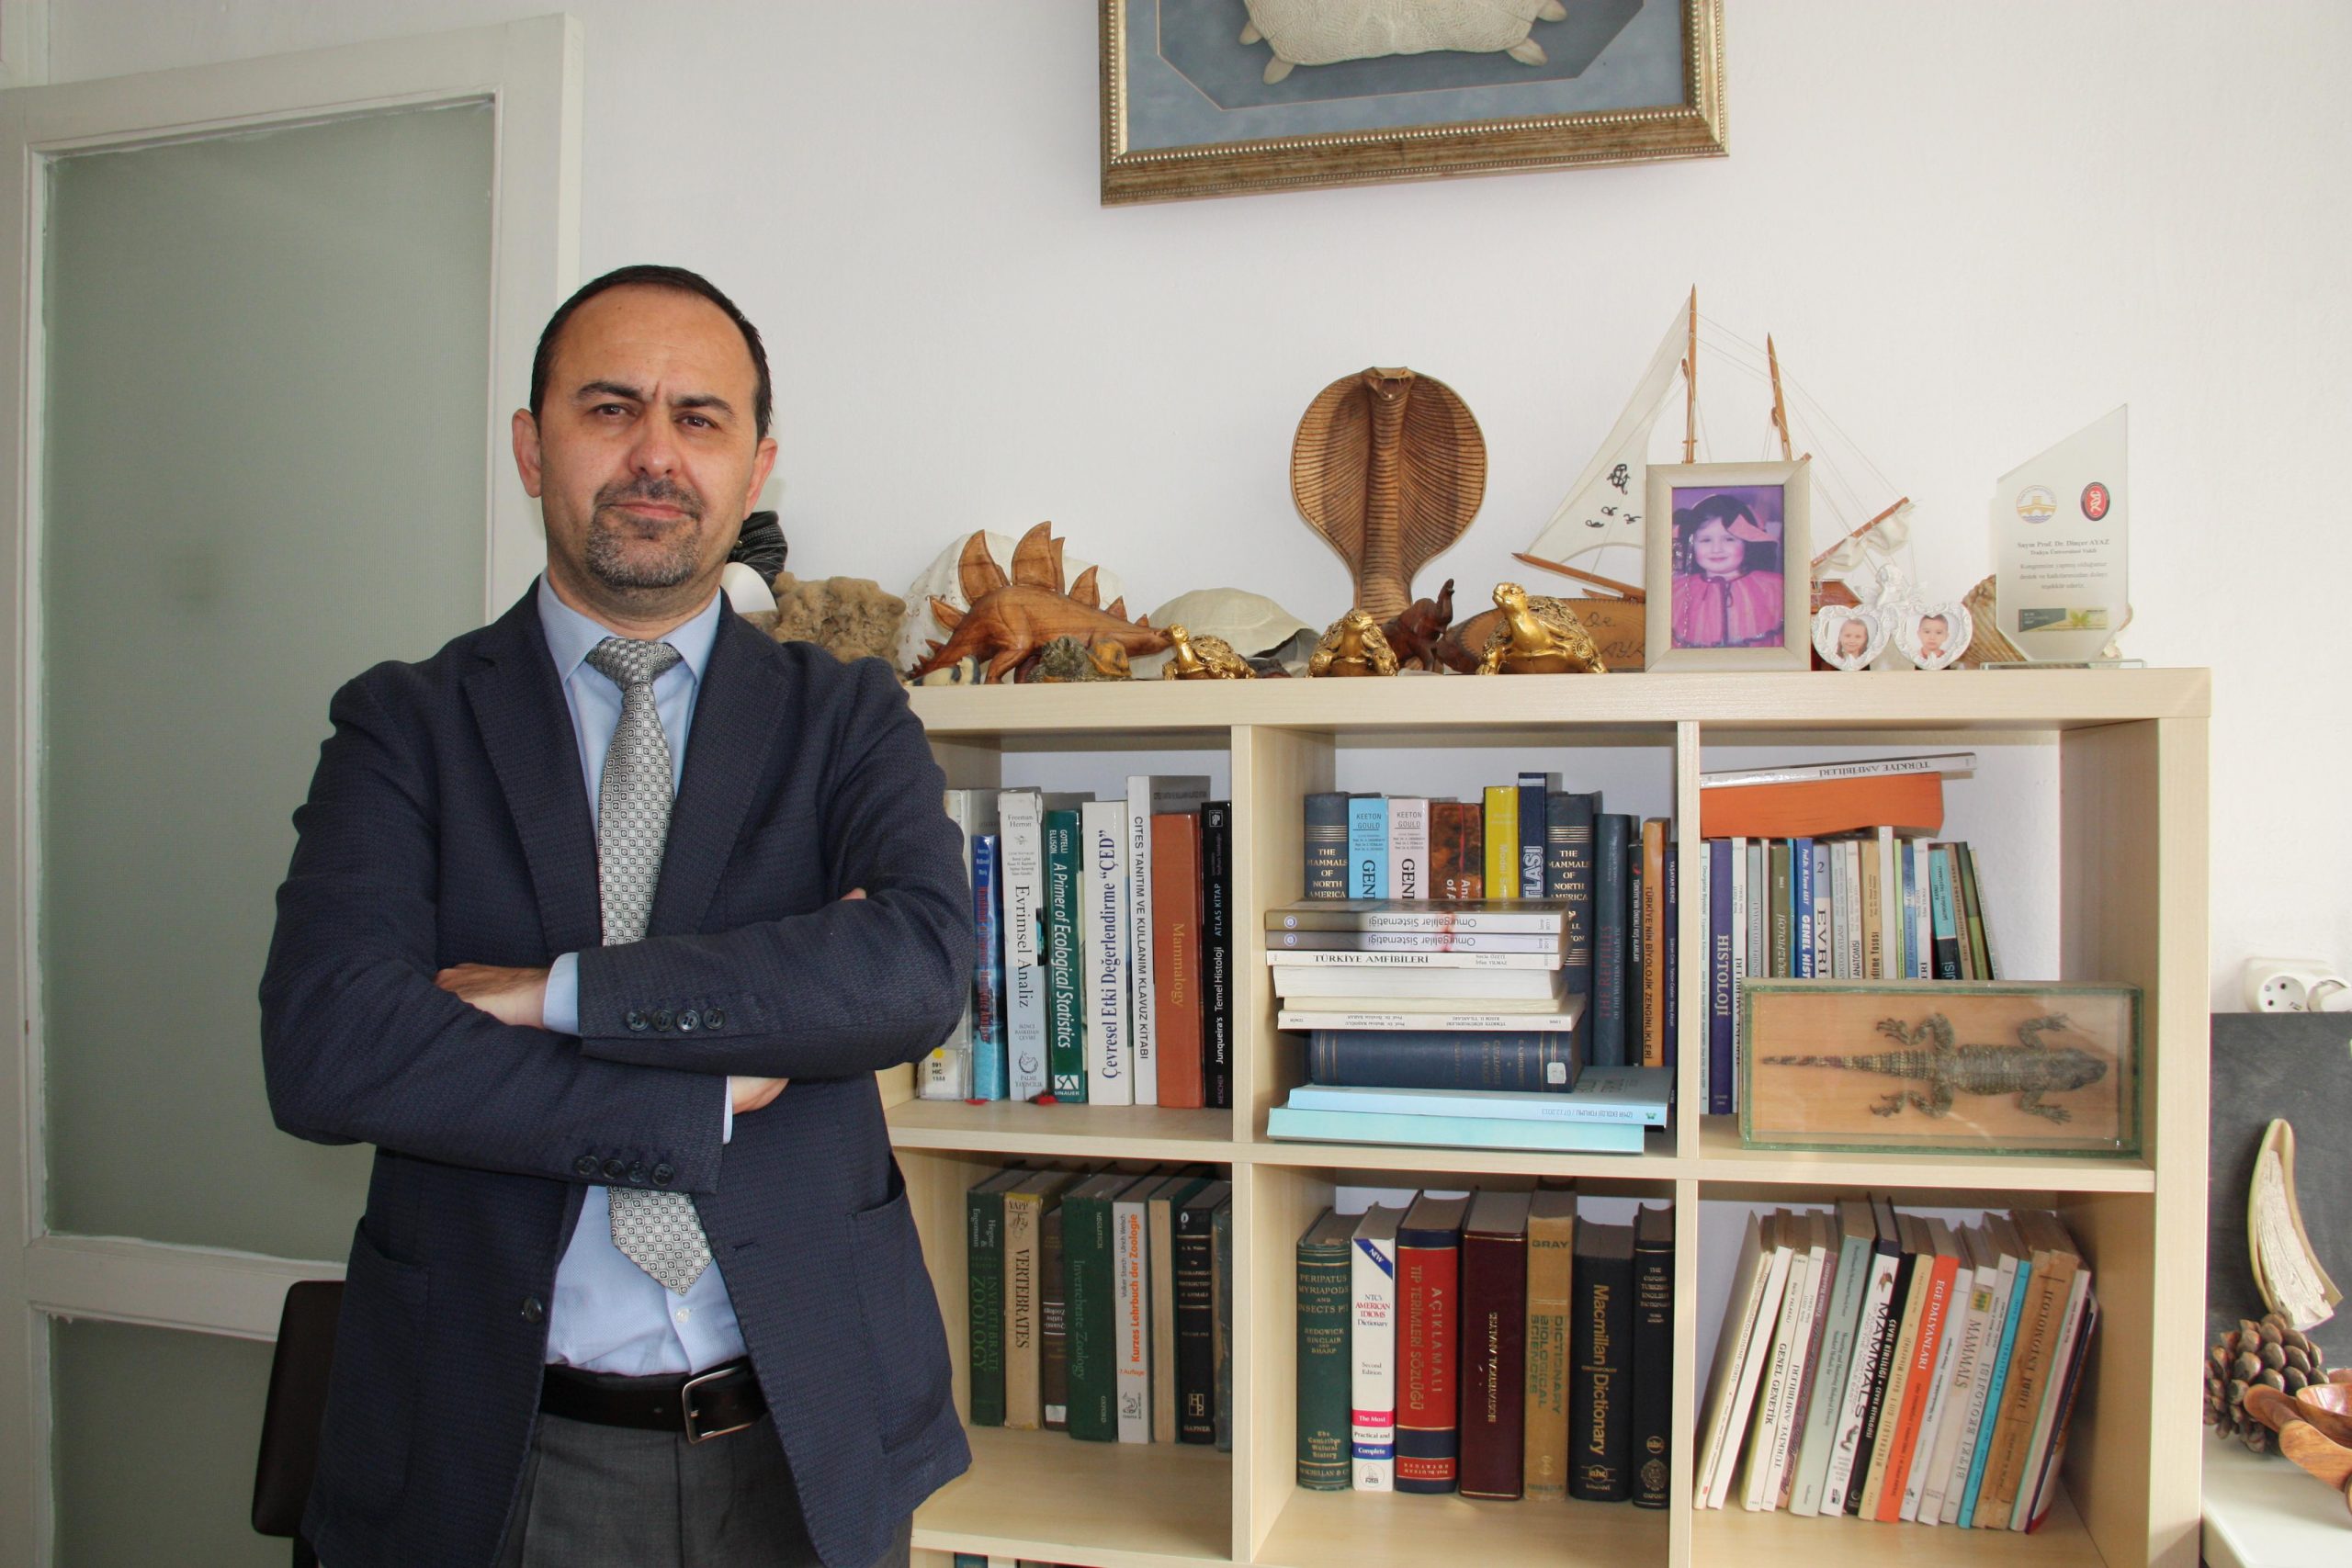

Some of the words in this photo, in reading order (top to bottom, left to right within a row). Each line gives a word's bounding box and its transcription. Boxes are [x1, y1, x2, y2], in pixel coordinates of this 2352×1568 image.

[1818, 764, 1880, 777] AMFİBİLERİ
[1882, 761, 1930, 772] TÜRKİYE
[1049, 829, 1058, 854] ELLISON
[1059, 829, 1069, 853] GOTELLI
[1134, 816, 1145, 849] CITES
[1397, 820, 1420, 829] GOULD
[1054, 863, 1066, 872] A
[1317, 848, 1337, 856] THE
[1816, 862, 1825, 874] 2
[1054, 873, 1068, 907] Primer
[1136, 852, 1146, 897] TANITIM
[1313, 880, 1342, 888] NORTH
[1320, 869, 1333, 877] OF
[1363, 859, 1376, 899] GEN
[1401, 858, 1416, 899] GEN
[1446, 879, 1456, 891] of
[1136, 900, 1146, 915] VE
[1213, 884, 1223, 908] KİTAP
[1308, 890, 1346, 898] AMERICA
[1015, 886, 1032, 953] Evrimsel
[1054, 908, 1069, 923] of
[1214, 910, 1223, 937] ATLAS
[1099, 883, 1120, 984] Değerlendirme
[1136, 917, 1147, 974] KULLANIM
[1802, 915, 1812, 952] GENEL
[1052, 924, 1073, 989] Ecological
[1171, 923, 1187, 1007] Mammalogy
[1213, 946, 1225, 984] Histoloji
[1313, 953, 1363, 963] TÜRKİYE
[1365, 953, 1429, 964] AMFİBİLERİ
[1645, 943, 1654, 991] BİYOLOJİK
[1849, 940, 1860, 976] ANATOMİSİ
[1017, 959, 1034, 1009] Analiz
[1715, 933, 1731, 1016] HİSTOLOJİ
[1101, 988, 1117, 1017] Etki
[1138, 977, 1148, 1021] KLAVUZ
[1214, 985, 1224, 1011] Temel
[1598, 991, 1611, 1019] THE
[1057, 990, 1074, 1047] Statistics
[1644, 992, 1655, 1059] ZENGİNLİKLERİ
[1101, 1021, 1119, 1078] Çevresel
[1138, 1023, 1149, 1059] KİTABI
[1009, 1201, 1029, 1212] YAPP
[972, 1208, 981, 1247] Engemann
[988, 1219, 996, 1248] Hegner
[1127, 1214, 1139, 1258] Zoologie
[1128, 1261, 1138, 1278] der
[1369, 1247, 1384, 1263] NEW
[1297, 1286, 1350, 1294] MYRIAPODS
[1299, 1273, 1348, 1282] PERIPATUS
[1410, 1265, 1422, 1282] TIP
[1932, 1280, 1946, 1302] EGE
[1015, 1248, 1030, 1348] VERTEBRATES
[1072, 1260, 1088, 1327] Invertebrate
[1129, 1280, 1139, 1327] Lehrbuch
[1298, 1304, 1336, 1314] INSECTS
[1355, 1301, 1390, 1310] AMERICAN
[971, 1277, 988, 1372] ZOOLOGY
[988, 1276, 999, 1373] INVERTEBRATE
[1305, 1327, 1344, 1336] SEDGWICK
[1357, 1318, 1387, 1327] Dictionary
[1360, 1310, 1385, 1318] IDIOMS
[1410, 1286, 1425, 1347] TERİMLERİ
[1593, 1284, 1610, 1365] Macmillan
[1884, 1318, 1897, 1343] ÇEVRE
[2025, 1290, 2055, 1372] ENTOMOLOJİ
[1130, 1330, 1140, 1362] Kurzes
[1306, 1336, 1341, 1344] SINCLAIR
[1428, 1288, 1443, 1392] AÇIKLAMALI
[1488, 1312, 1498, 1355] ANALYSIS
[1916, 1302, 1942, 1371] DALYANLARI
[1071, 1331, 1089, 1381] Zoology
[1529, 1314, 1539, 1394] SCIENCES
[1538, 1314, 1550, 1408] BIOLOGICAL
[1552, 1314, 1564, 1415] DICTIONARY
[1772, 1342, 1790, 1378] GENEL
[1852, 1303, 1892, 1419] MAMMALS
[1877, 1344, 1894, 1379] KİRLİLİĞİ
[1952, 1319, 1984, 1389] MAMMALS
[1123, 1368, 1146, 1377] Auflage
[1362, 1368, 1382, 1376] Edition
[1410, 1351, 1426, 1410] SÖZLÜĞÜ
[1762, 1379, 1784, 1426] GENETİK
[1871, 1386, 1883, 1404] ÇEVRE
[1589, 1374, 1609, 1455] Dictionary
[1953, 1440, 1973, 1480] BİTKİ
[1963, 1362, 1992, 1435] EKOLOJİSİ
[1354, 1430, 1377, 1438] Practical
[1358, 1447, 1385, 1456] Complete
[1770, 1423, 1791, 1469] TÜRKİYE
